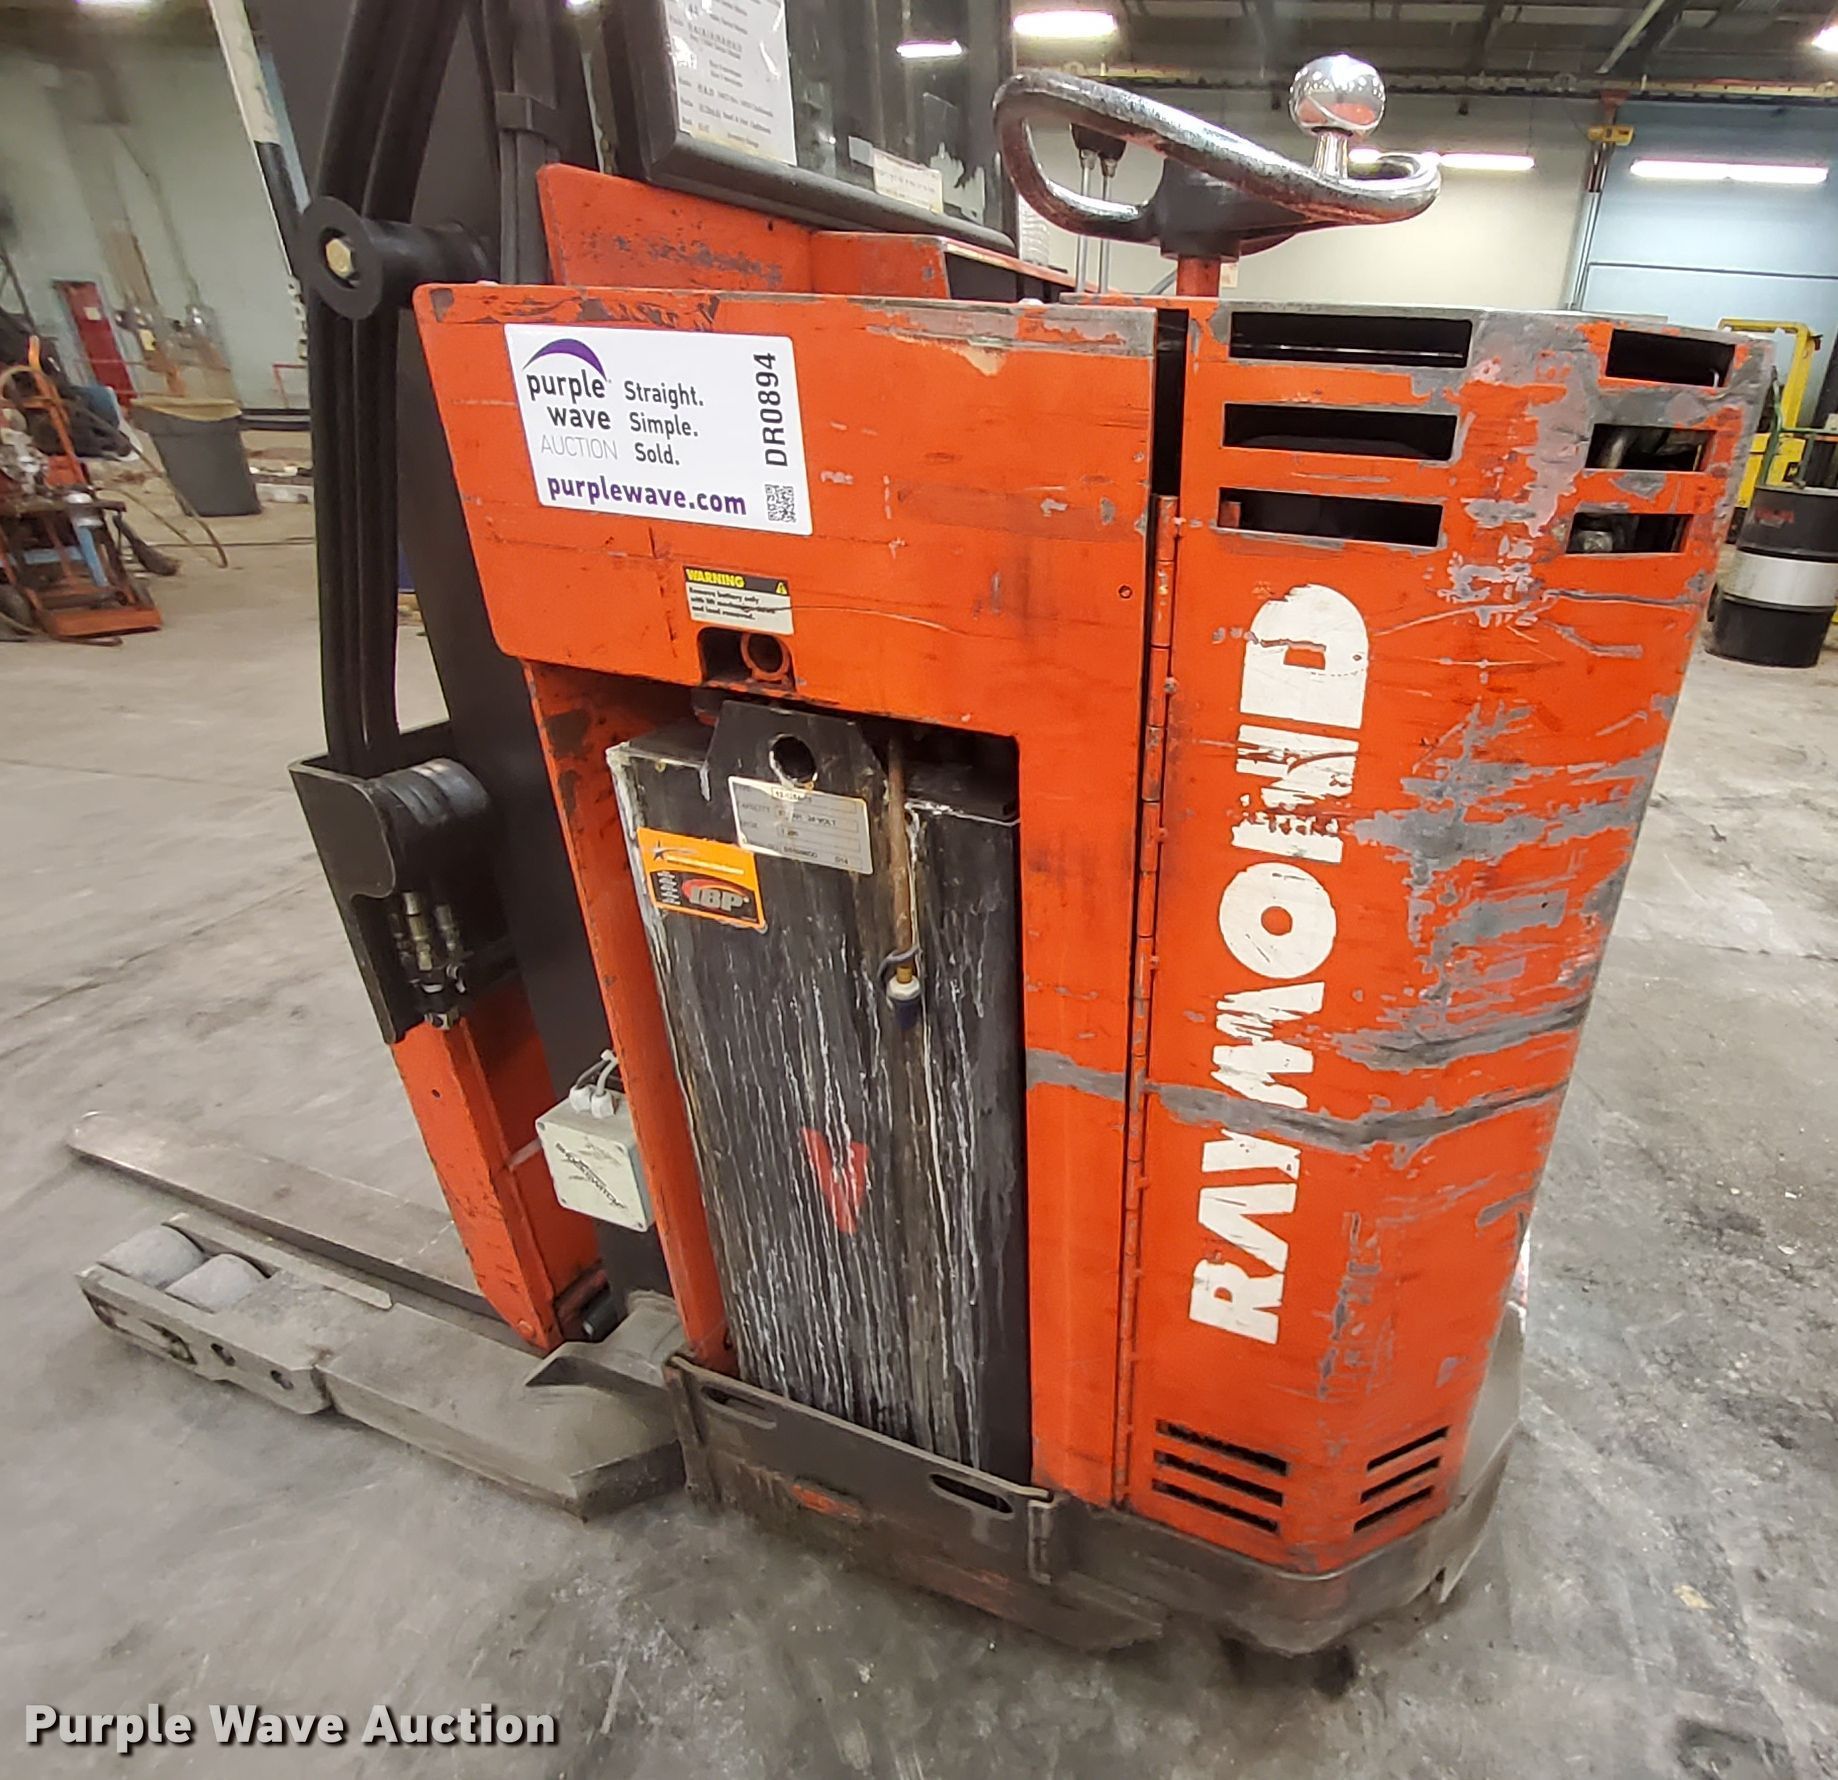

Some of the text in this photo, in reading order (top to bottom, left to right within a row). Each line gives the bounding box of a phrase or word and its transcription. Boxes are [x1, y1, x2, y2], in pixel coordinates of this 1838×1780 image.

[527, 370, 605, 400] purple
[624, 381, 704, 408] Straight.
[547, 405, 611, 429] wave
[754, 353, 788, 466] DR0894
[630, 412, 698, 438] Simple.
[541, 435, 618, 460] AUCTION
[635, 443, 680, 465] Sold.
[548, 476, 746, 515] purplewave.com
[686, 569, 745, 588] WARNING
[688, 886, 743, 912] IBP
[1189, 583, 1370, 1344] RAYMOND
